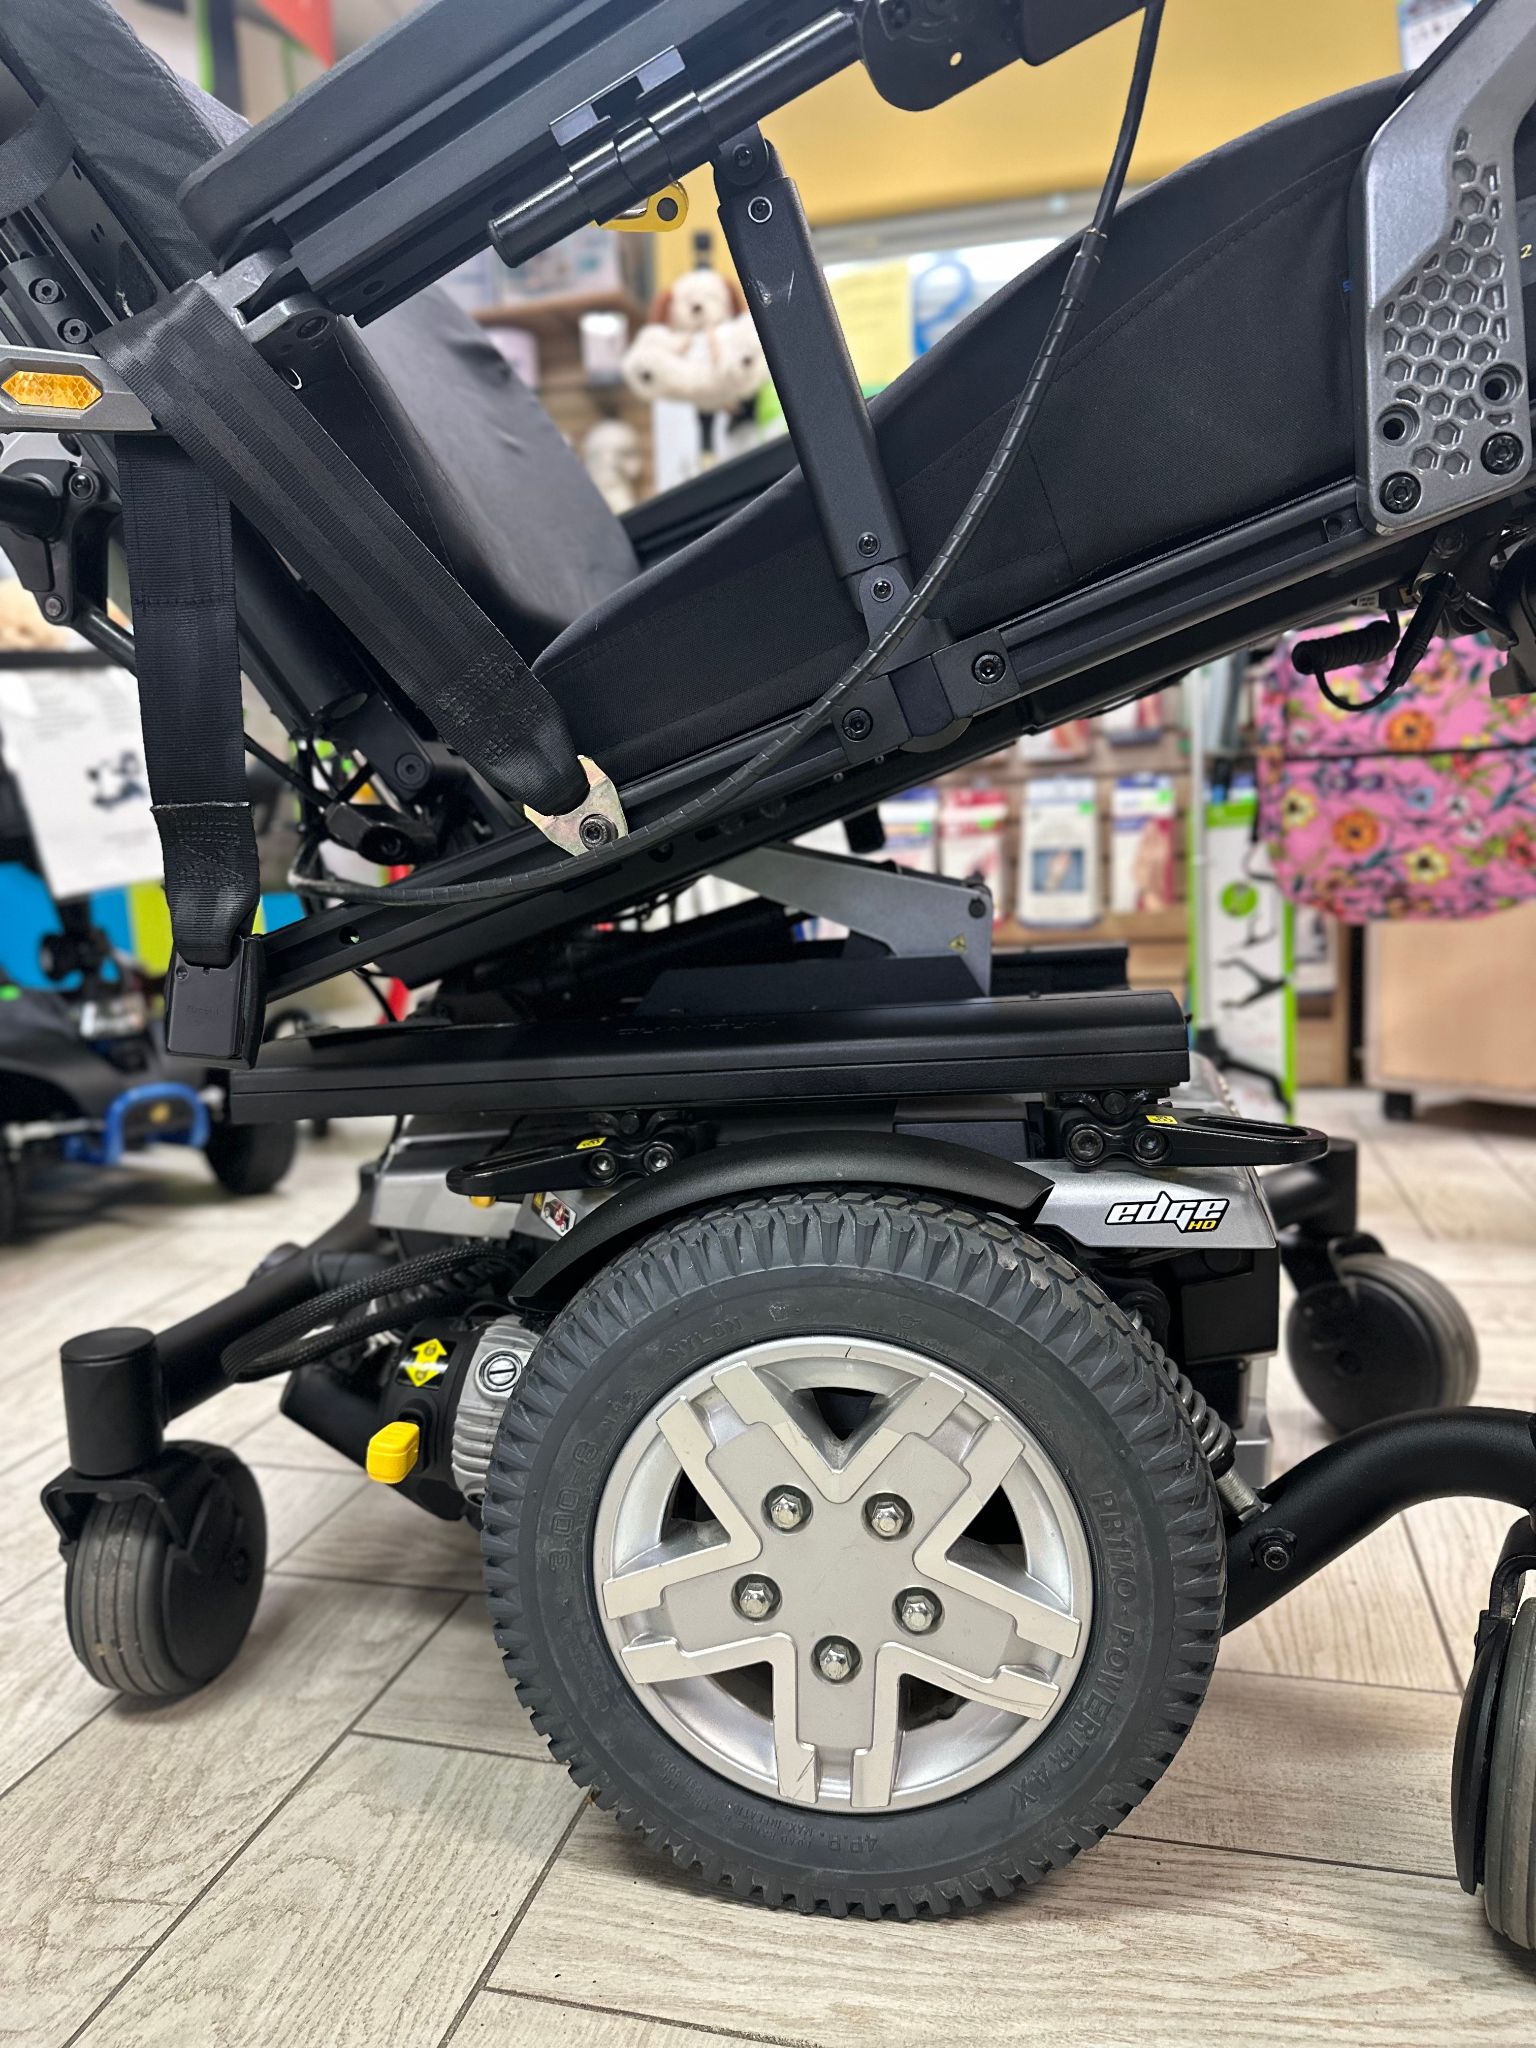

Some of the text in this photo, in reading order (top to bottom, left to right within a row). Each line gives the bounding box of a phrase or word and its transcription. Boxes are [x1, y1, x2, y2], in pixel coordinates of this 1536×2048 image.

[1106, 1193, 1228, 1231] edge
[1187, 1220, 1216, 1230] HD
[547, 1438, 602, 1572] 3.00-8
